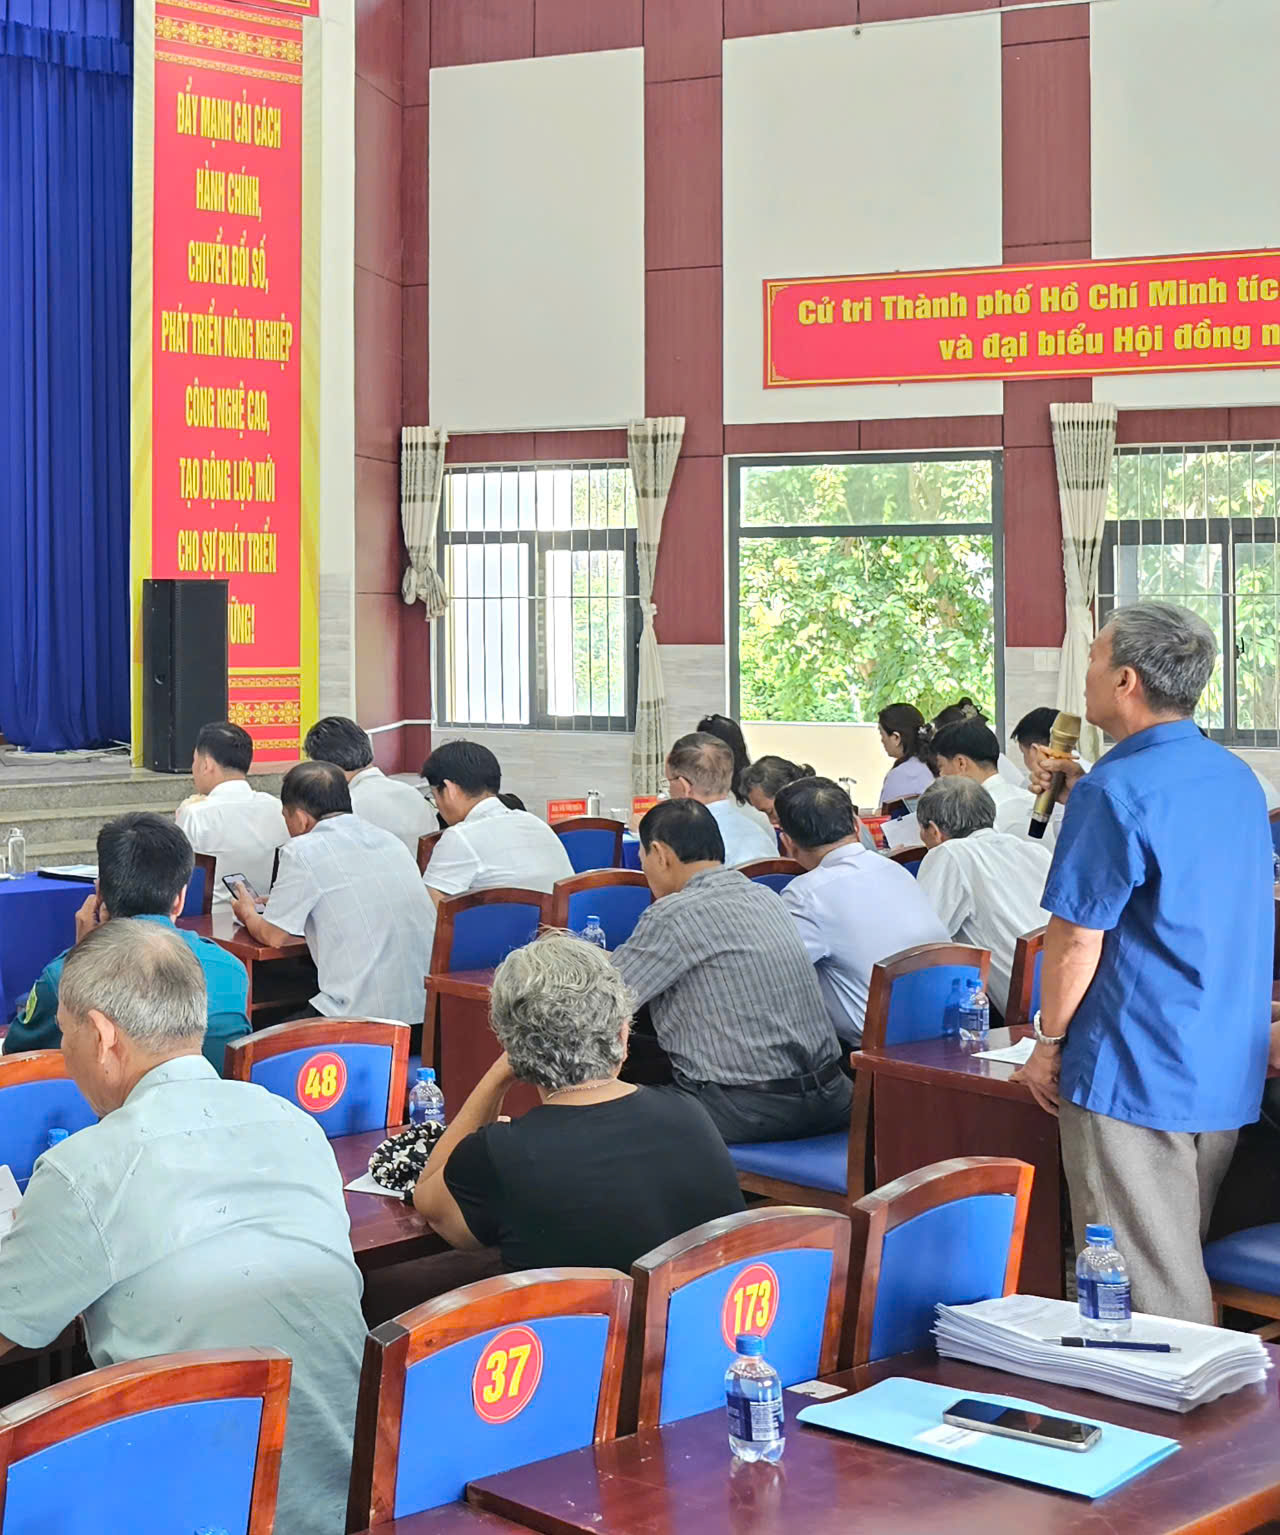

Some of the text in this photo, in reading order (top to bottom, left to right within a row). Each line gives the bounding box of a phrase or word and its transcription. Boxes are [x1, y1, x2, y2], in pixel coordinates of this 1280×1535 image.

[177, 76, 280, 148] ĐẨY MẠNH CẢI CÁCH
[196, 160, 261, 222] HÀNH CHÍNH,
[188, 227, 268, 294] CHUYỂN ĐỔI SỐ,
[799, 296, 835, 324] Cử
[842, 297, 871, 322] tri
[881, 293, 967, 320] Thành
[977, 284, 1032, 319] phố
[1041, 282, 1078, 312] Hồ
[1089, 282, 1138, 310] Chí
[1149, 278, 1226, 307] Minh
[162, 299, 292, 370] PHÁT TRIỂN NÔNG NGHIỆP
[939, 334, 972, 360] và
[983, 332, 1027, 363] đại
[1038, 323, 1103, 356] biểu
[1114, 325, 1162, 357] Hội
[1174, 319, 1250, 350] đồng
[186, 378, 269, 438] CÔNG NGHỆ CAO,
[180, 451, 275, 510] TẠO ĐỘNG LỰC MỚI
[178, 517, 276, 579] CHO SỰ PHÁT TRIỂN
[228, 596, 255, 644] ỮNG!
[304, 1063, 337, 1099] 48
[733, 1279, 771, 1335] 173
[482, 1343, 532, 1405] 37
